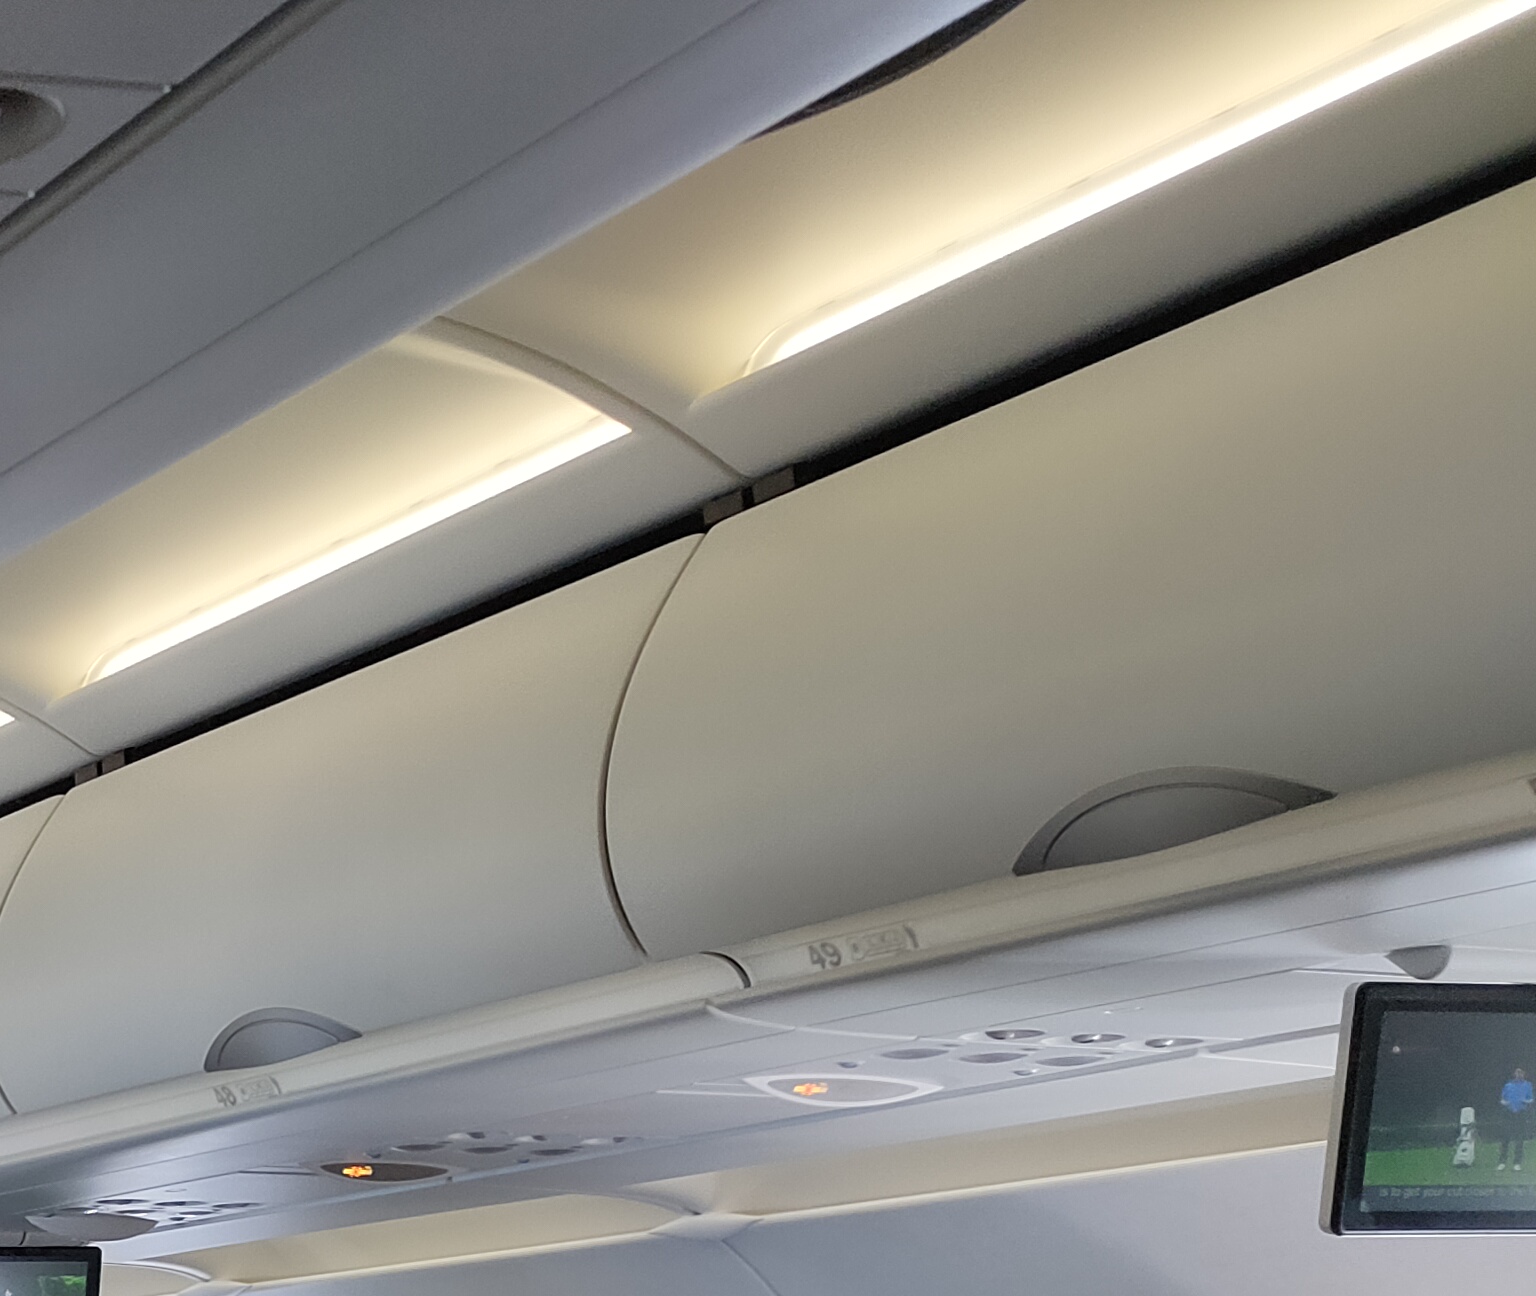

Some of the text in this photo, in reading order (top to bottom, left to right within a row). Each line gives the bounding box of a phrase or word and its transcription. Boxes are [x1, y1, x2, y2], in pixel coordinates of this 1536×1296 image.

[808, 941, 842, 969] 49
[213, 1086, 237, 1107] 48
[1422, 1188, 1444, 1198] your
